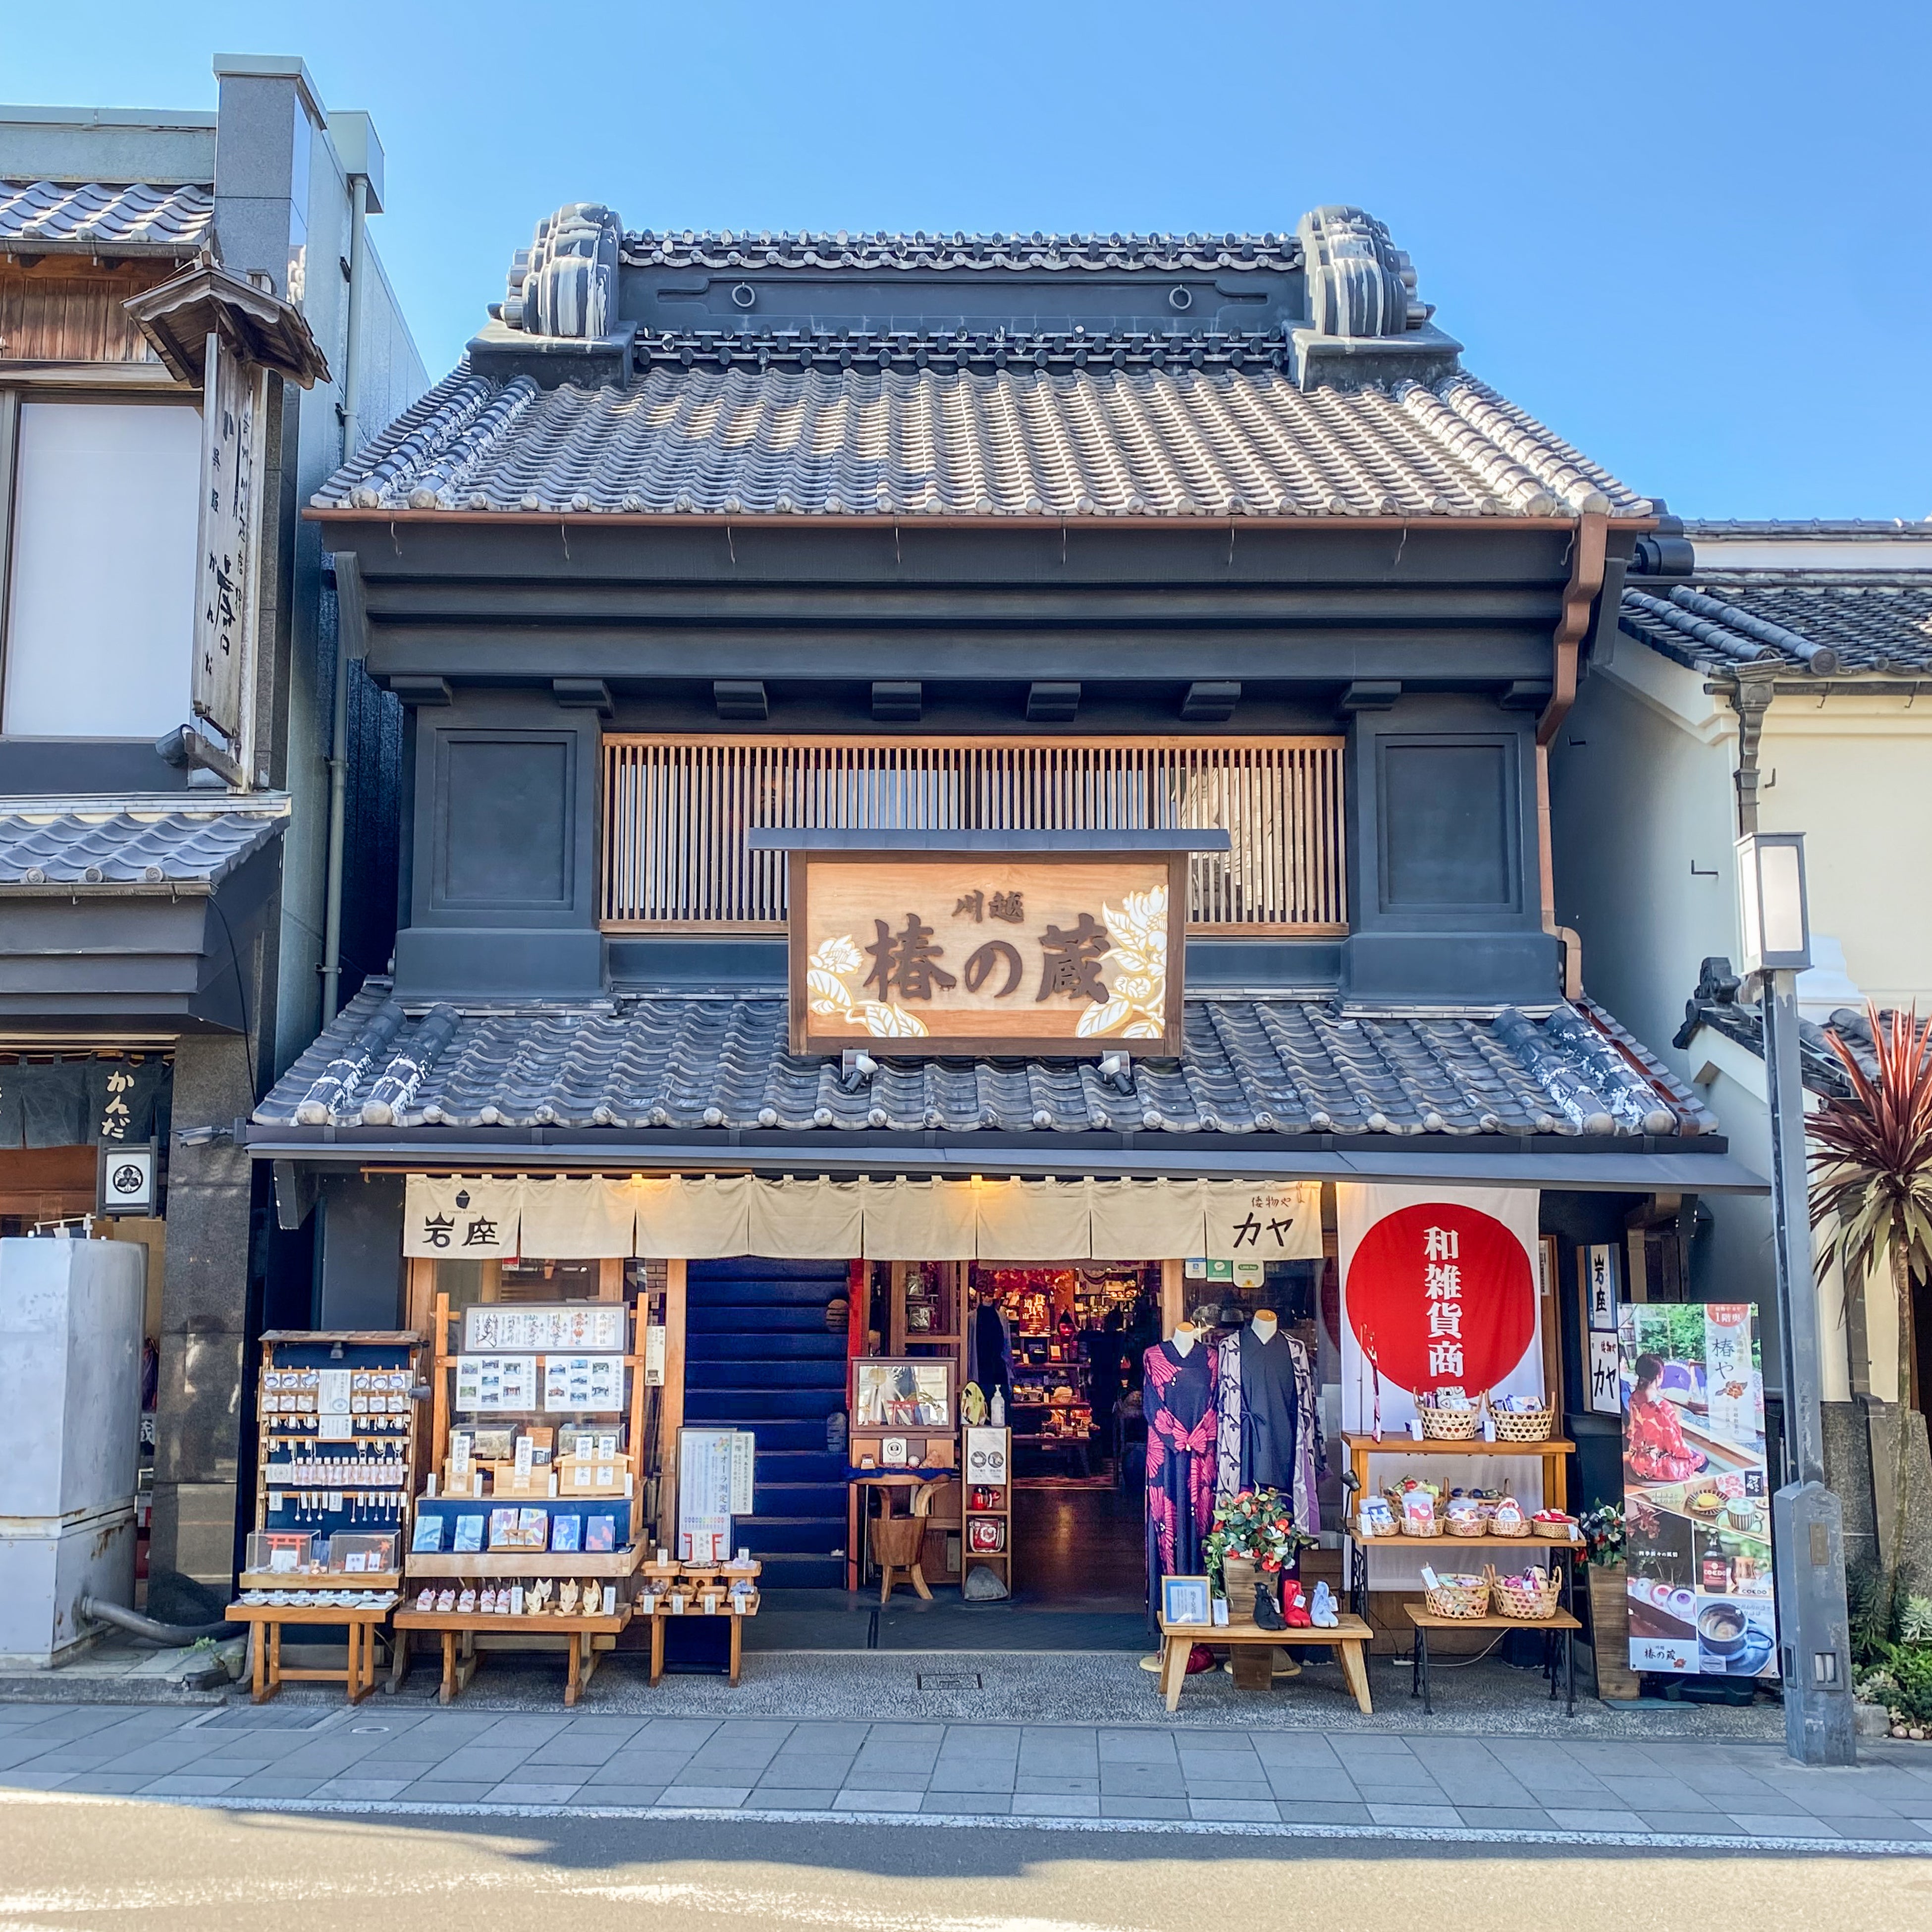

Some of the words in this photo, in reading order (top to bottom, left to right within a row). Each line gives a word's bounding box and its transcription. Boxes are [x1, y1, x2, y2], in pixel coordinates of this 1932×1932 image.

[952, 889, 1024, 923] 川越
[863, 912, 1110, 1004] 椿の蔵
[102, 1071, 135, 1139] かんだ
[1252, 1196, 1291, 1207] 倭物や
[422, 1212, 499, 1247] 岩座
[1233, 1212, 1293, 1248] カヤ
[1423, 1226, 1464, 1378] 和雑貨商
[1594, 1253, 1607, 1312] 岩座
[1716, 1312, 1742, 1323] 1階奥
[1712, 1338, 1735, 1379] 椿や
[1594, 1359, 1616, 1399] カヤ
[719, 1455, 728, 1513] オーラ測定器
[1645, 1648, 1676, 1660] 椿の蔵
